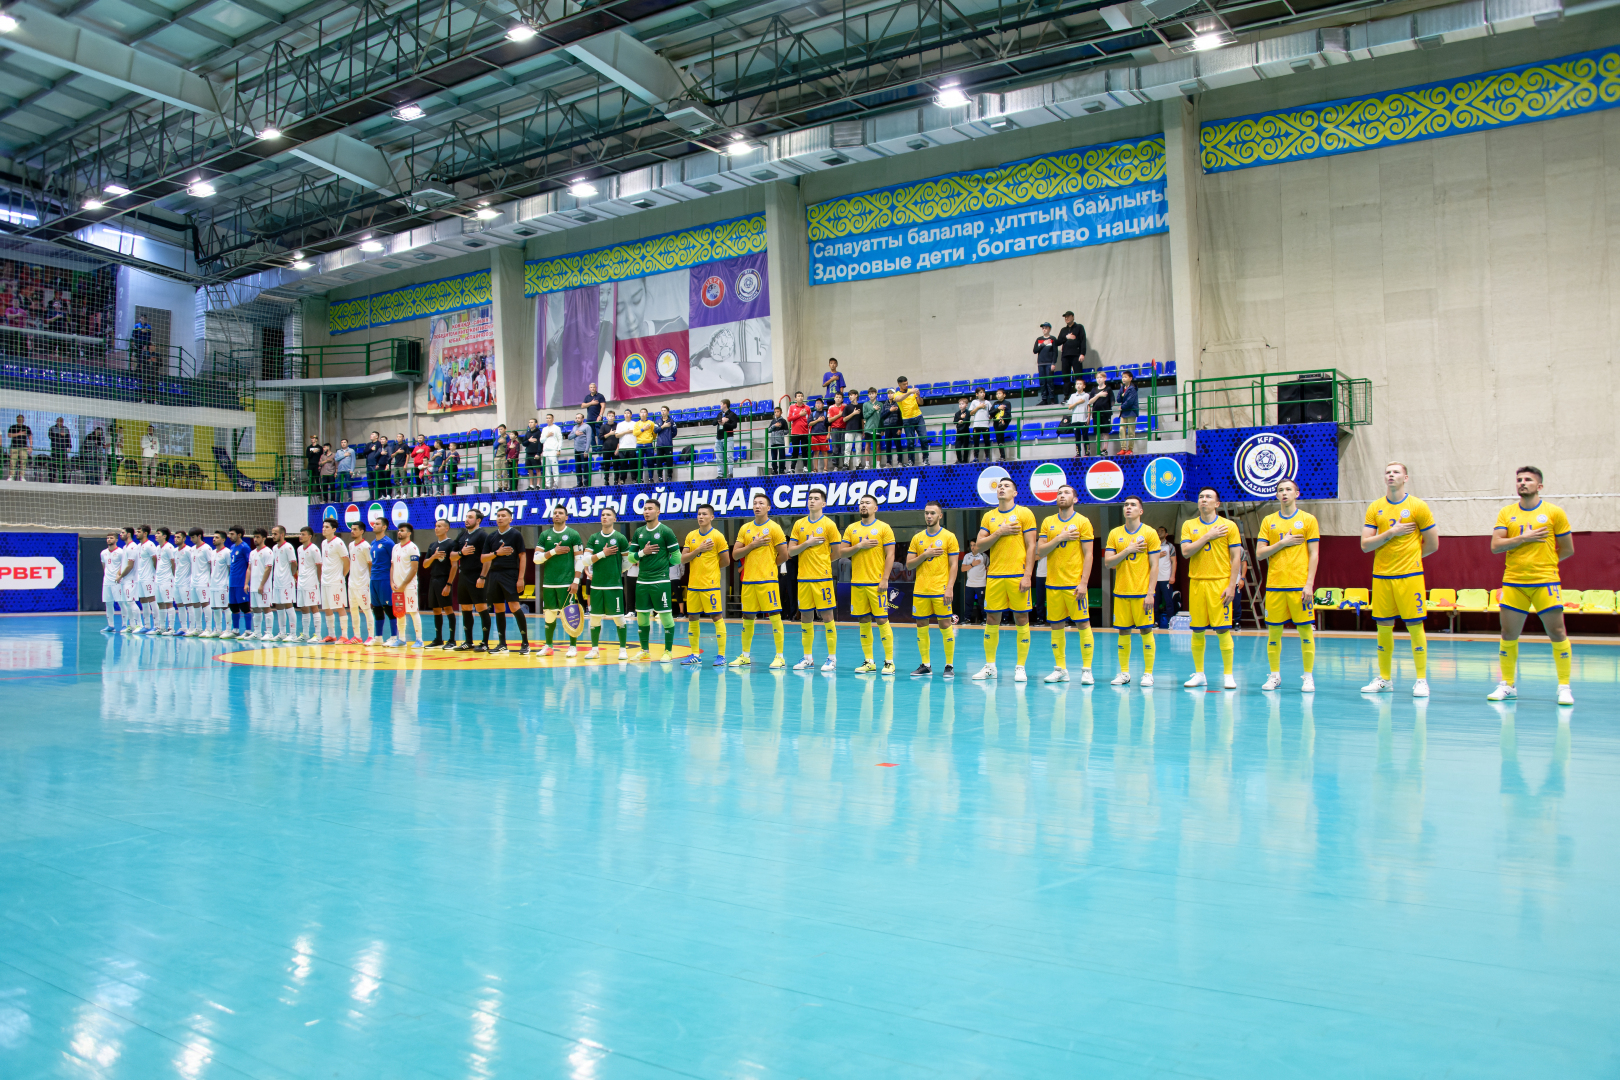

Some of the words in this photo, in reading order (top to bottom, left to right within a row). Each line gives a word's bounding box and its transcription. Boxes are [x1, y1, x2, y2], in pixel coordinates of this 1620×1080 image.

[813, 235, 903, 258] Салауатты
[907, 220, 984, 245] балалар
[813, 255, 912, 281] Здоровые
[916, 247, 965, 269] дети
[1097, 213, 1169, 238] нации
[705, 277, 720, 286] UEFA
[1257, 436, 1274, 444] KFF
[0, 566, 57, 579] PBET
[333, 593, 340, 602] 19
[362, 593, 367, 603] 5
[407, 596, 414, 604] 14
[661, 591, 667, 603] 4
[709, 593, 717, 605] 6
[767, 590, 777, 603] 11
[821, 587, 832, 601] 13
[1414, 592, 1423, 608] 3
[615, 597, 620, 608] 1
[877, 594, 887, 608] 12
